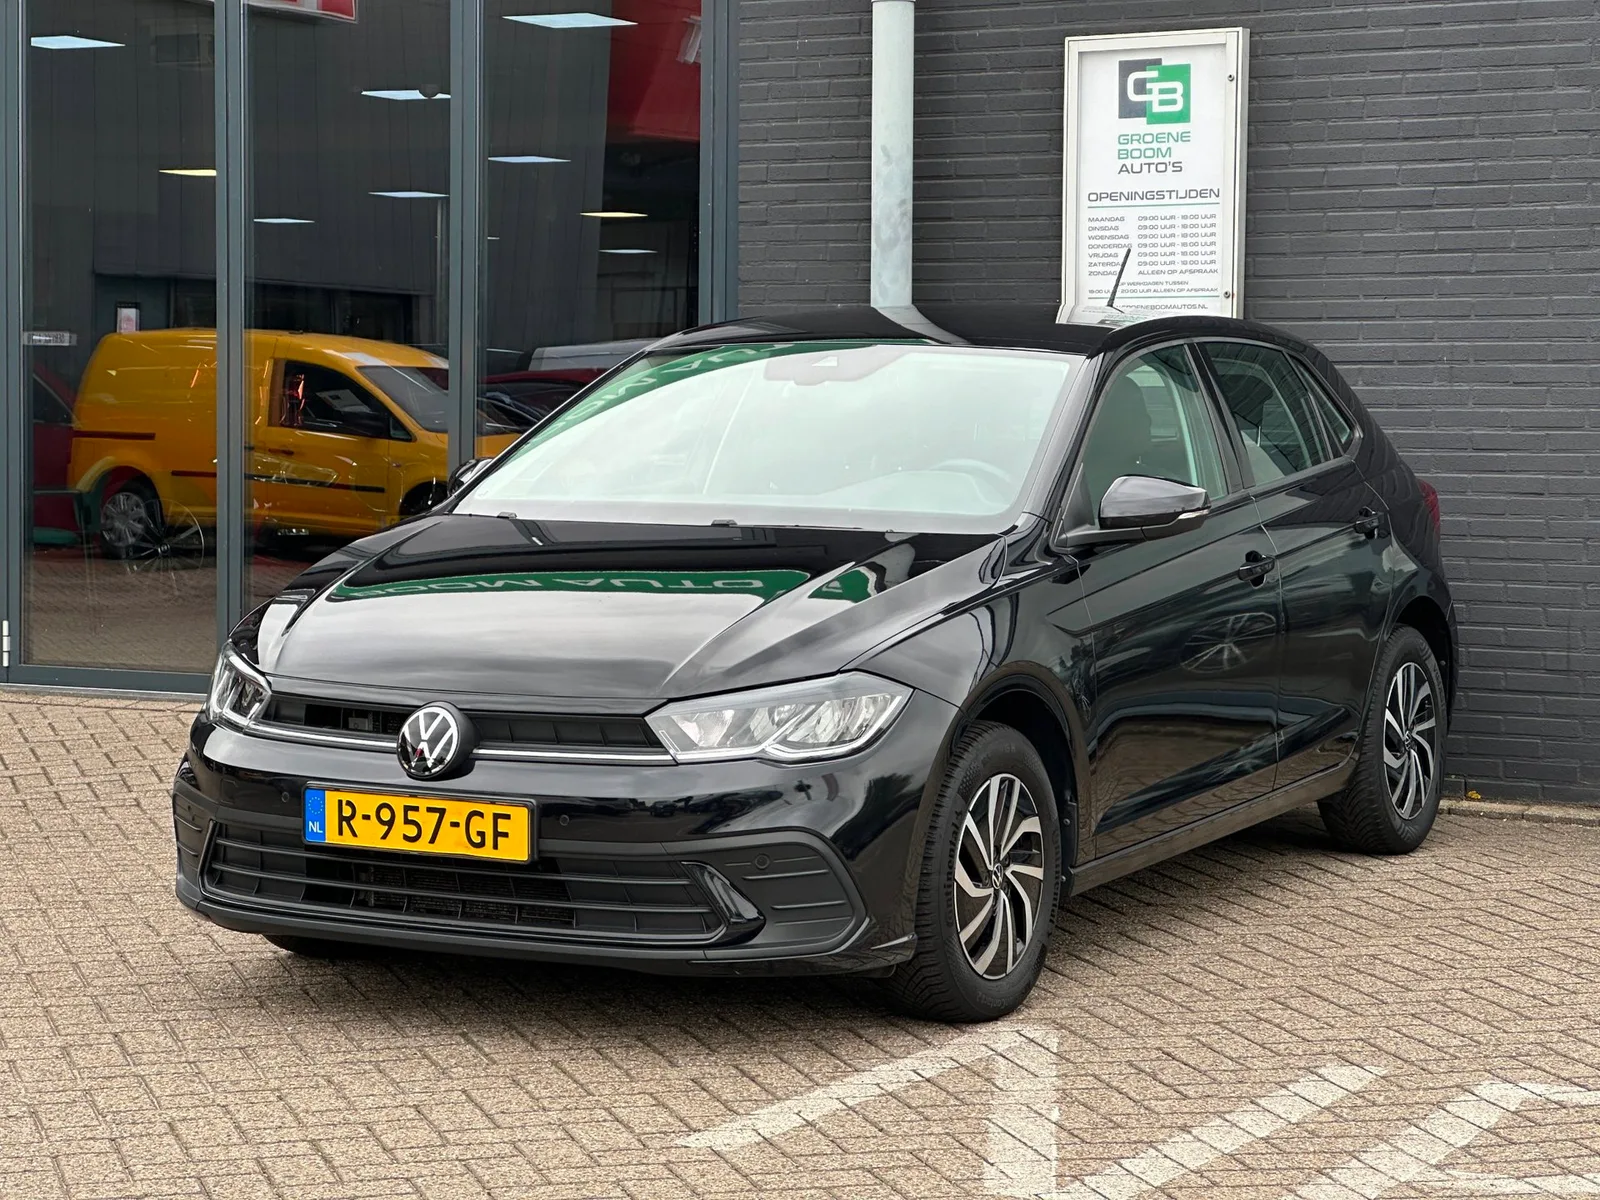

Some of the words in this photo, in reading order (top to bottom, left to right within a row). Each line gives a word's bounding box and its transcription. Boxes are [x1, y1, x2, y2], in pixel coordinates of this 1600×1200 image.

[1117, 131, 1191, 145] GROENE
[1117, 146, 1172, 160] BOOM
[1117, 161, 1183, 175] AUTO'S
[1087, 188, 1220, 203] OPENINGSTIJDEN
[308, 821, 323, 834] NL
[337, 799, 512, 851] R-957-GF
